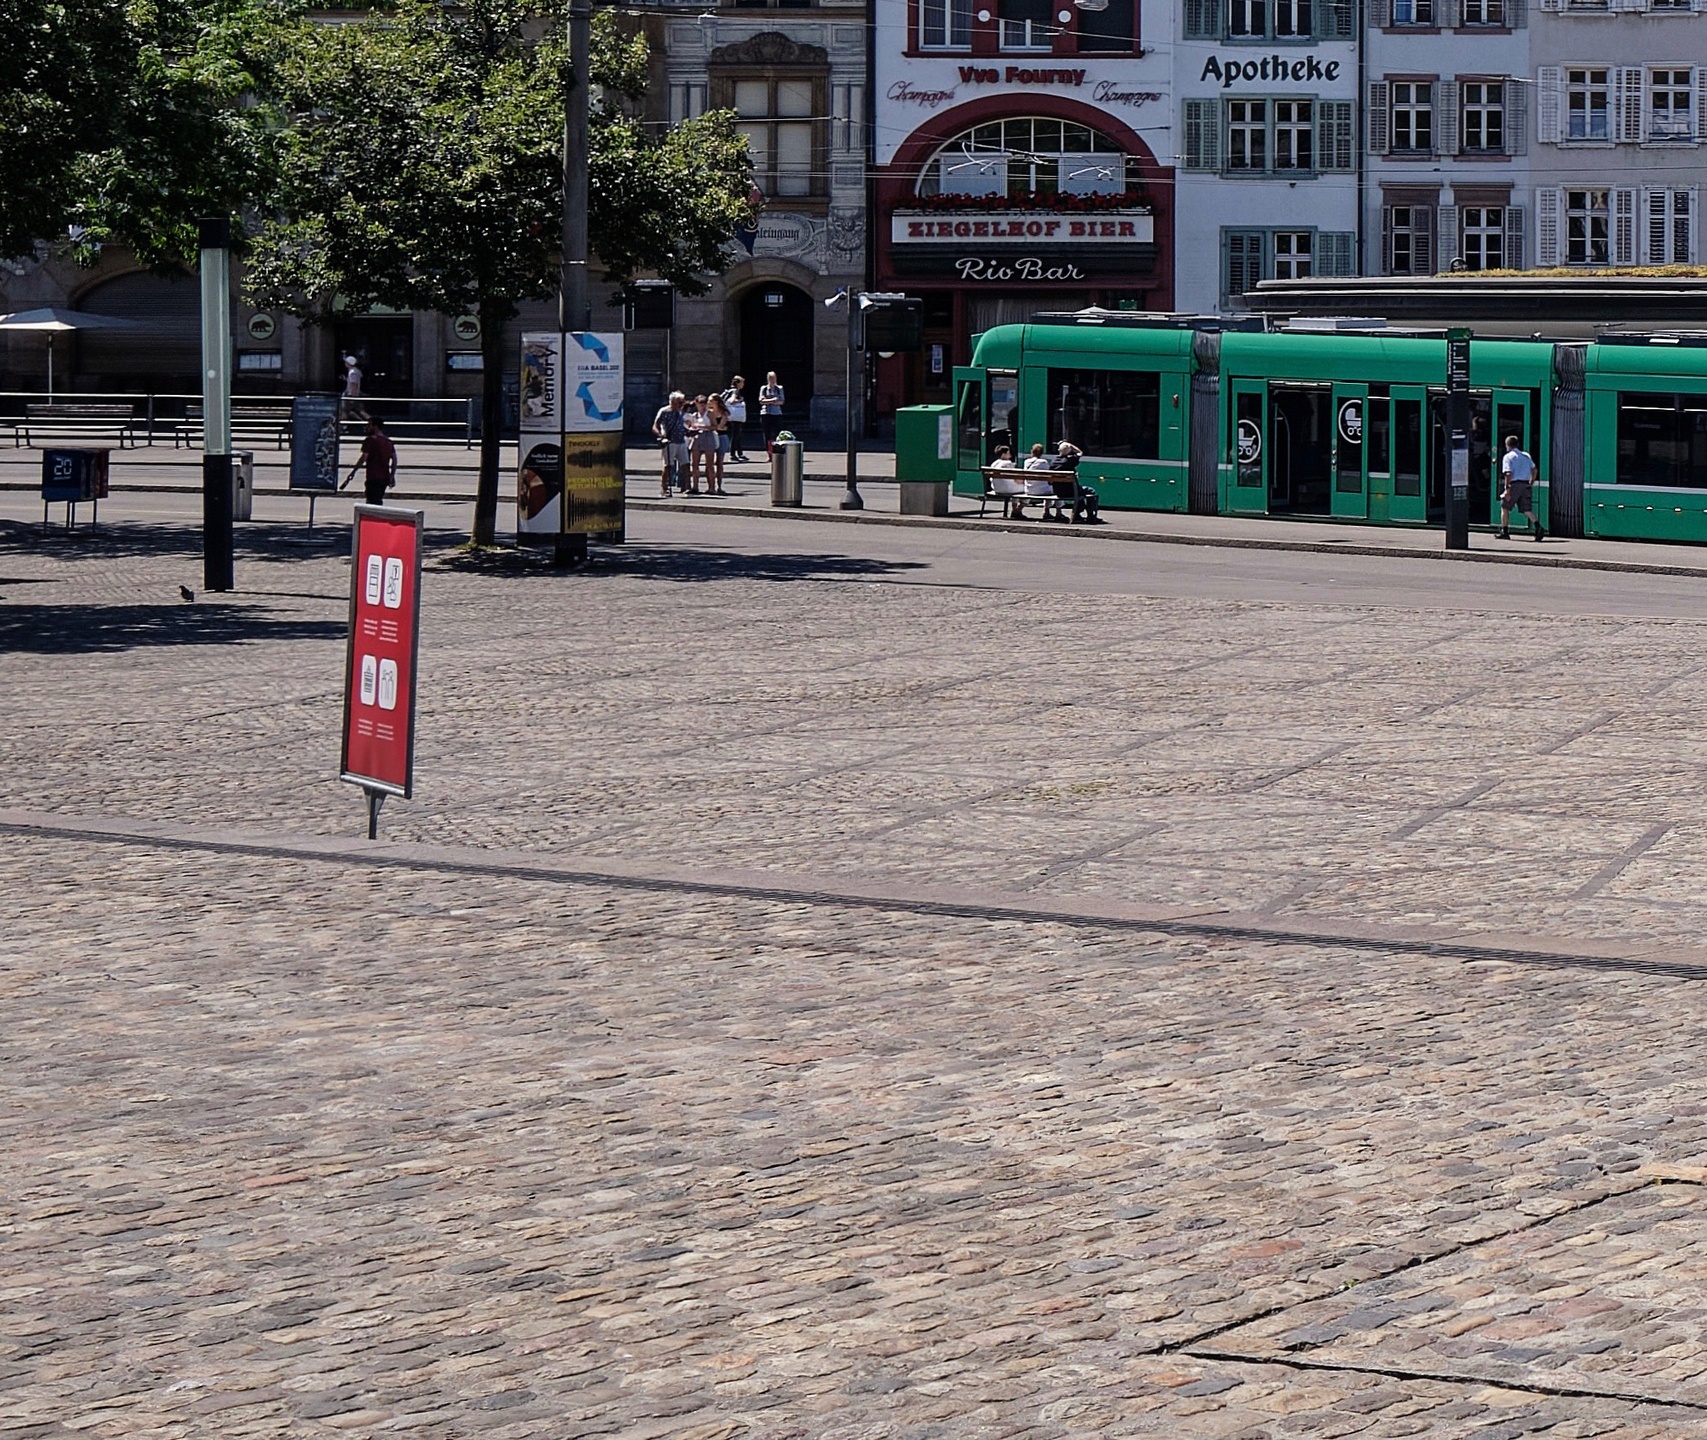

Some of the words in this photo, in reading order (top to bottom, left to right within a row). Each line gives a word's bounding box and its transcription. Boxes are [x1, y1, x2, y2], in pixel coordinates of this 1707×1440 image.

[958, 66, 999, 84] Vve
[1005, 66, 1086, 87] Fourny
[1200, 55, 1340, 88] Apotheke
[887, 80, 955, 107] Champagne
[1093, 80, 1163, 107] Champagne
[908, 221, 1060, 238] ZIEGELHOF
[1070, 221, 1137, 238] BIER
[955, 258, 1014, 280] Rio
[1015, 258, 1085, 280] Bar
[541, 347, 558, 417] Memory
